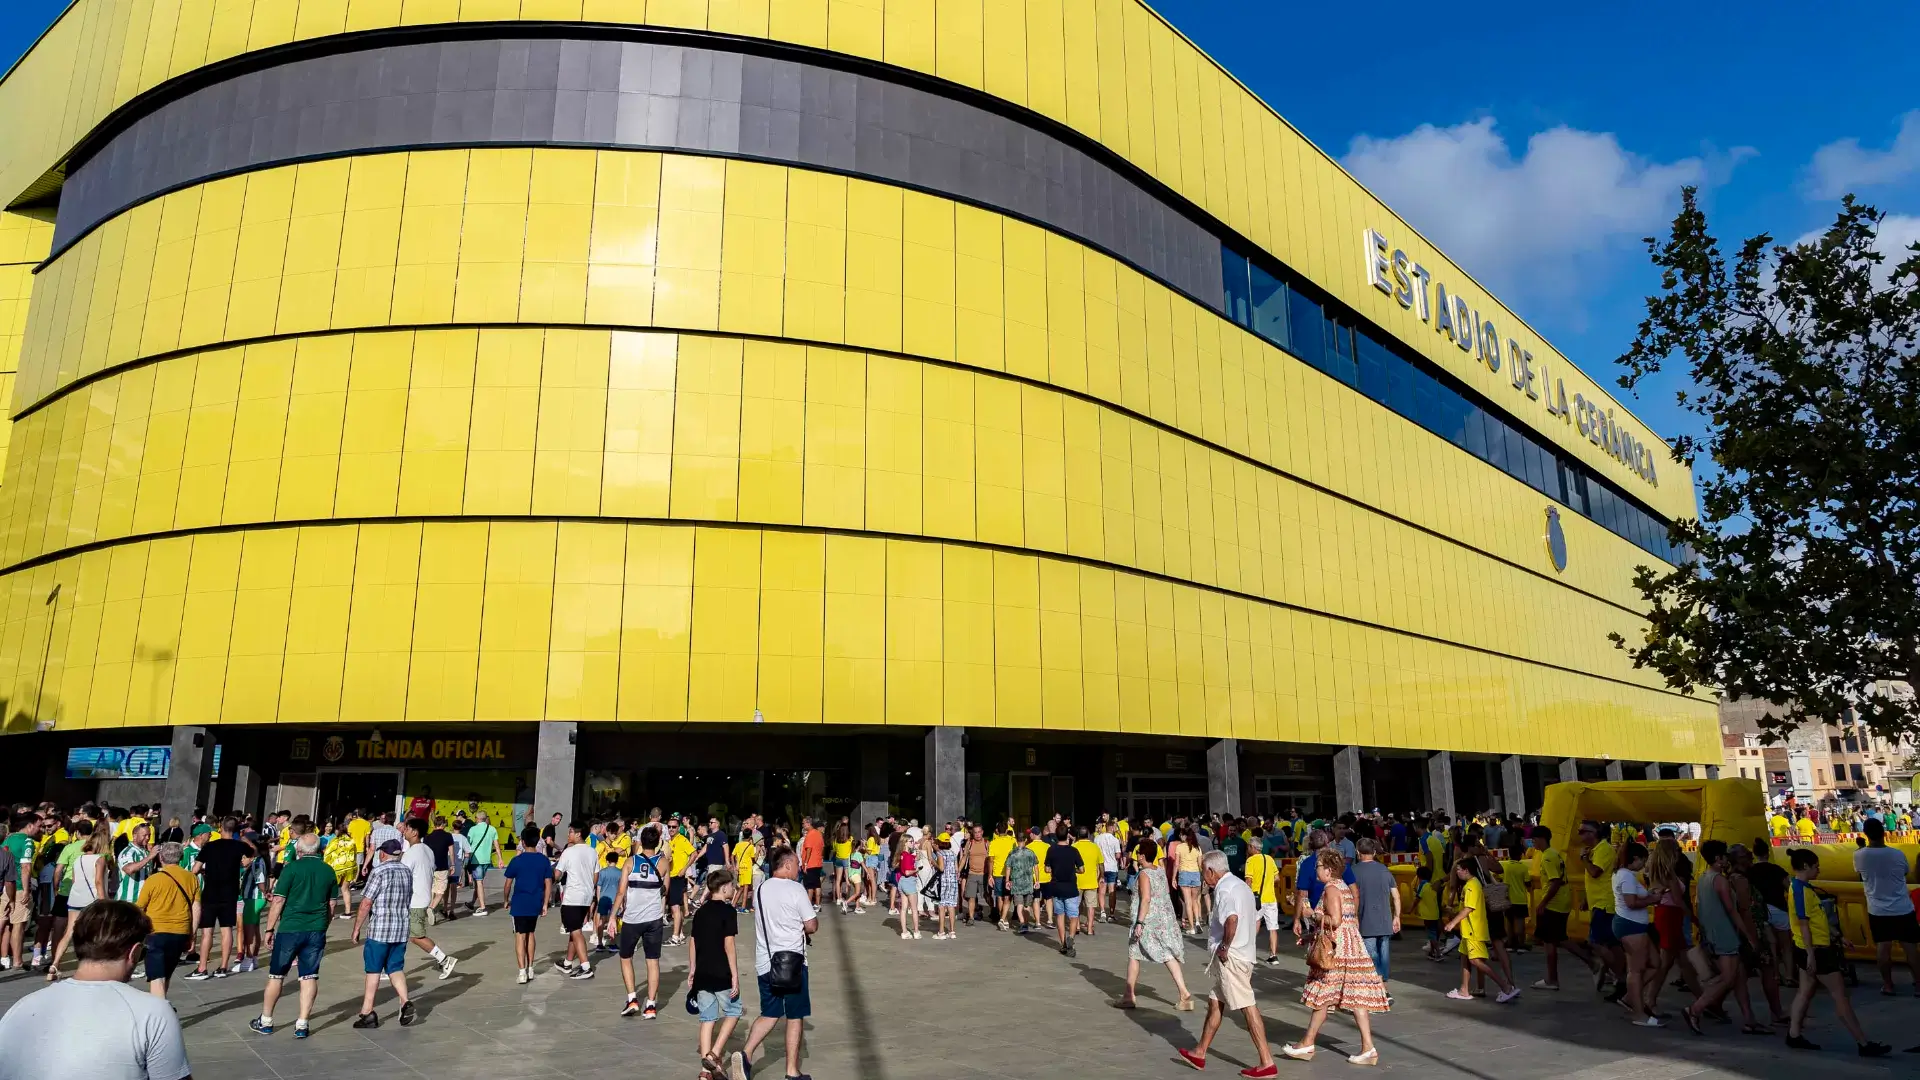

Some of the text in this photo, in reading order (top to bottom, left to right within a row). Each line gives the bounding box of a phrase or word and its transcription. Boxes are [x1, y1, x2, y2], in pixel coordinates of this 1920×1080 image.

[1363, 228, 1659, 487] ESTADIO DE LA CERÁMICA
[356, 739, 506, 760] TIENDA OFICIAL
[639, 862, 650, 880] 9
